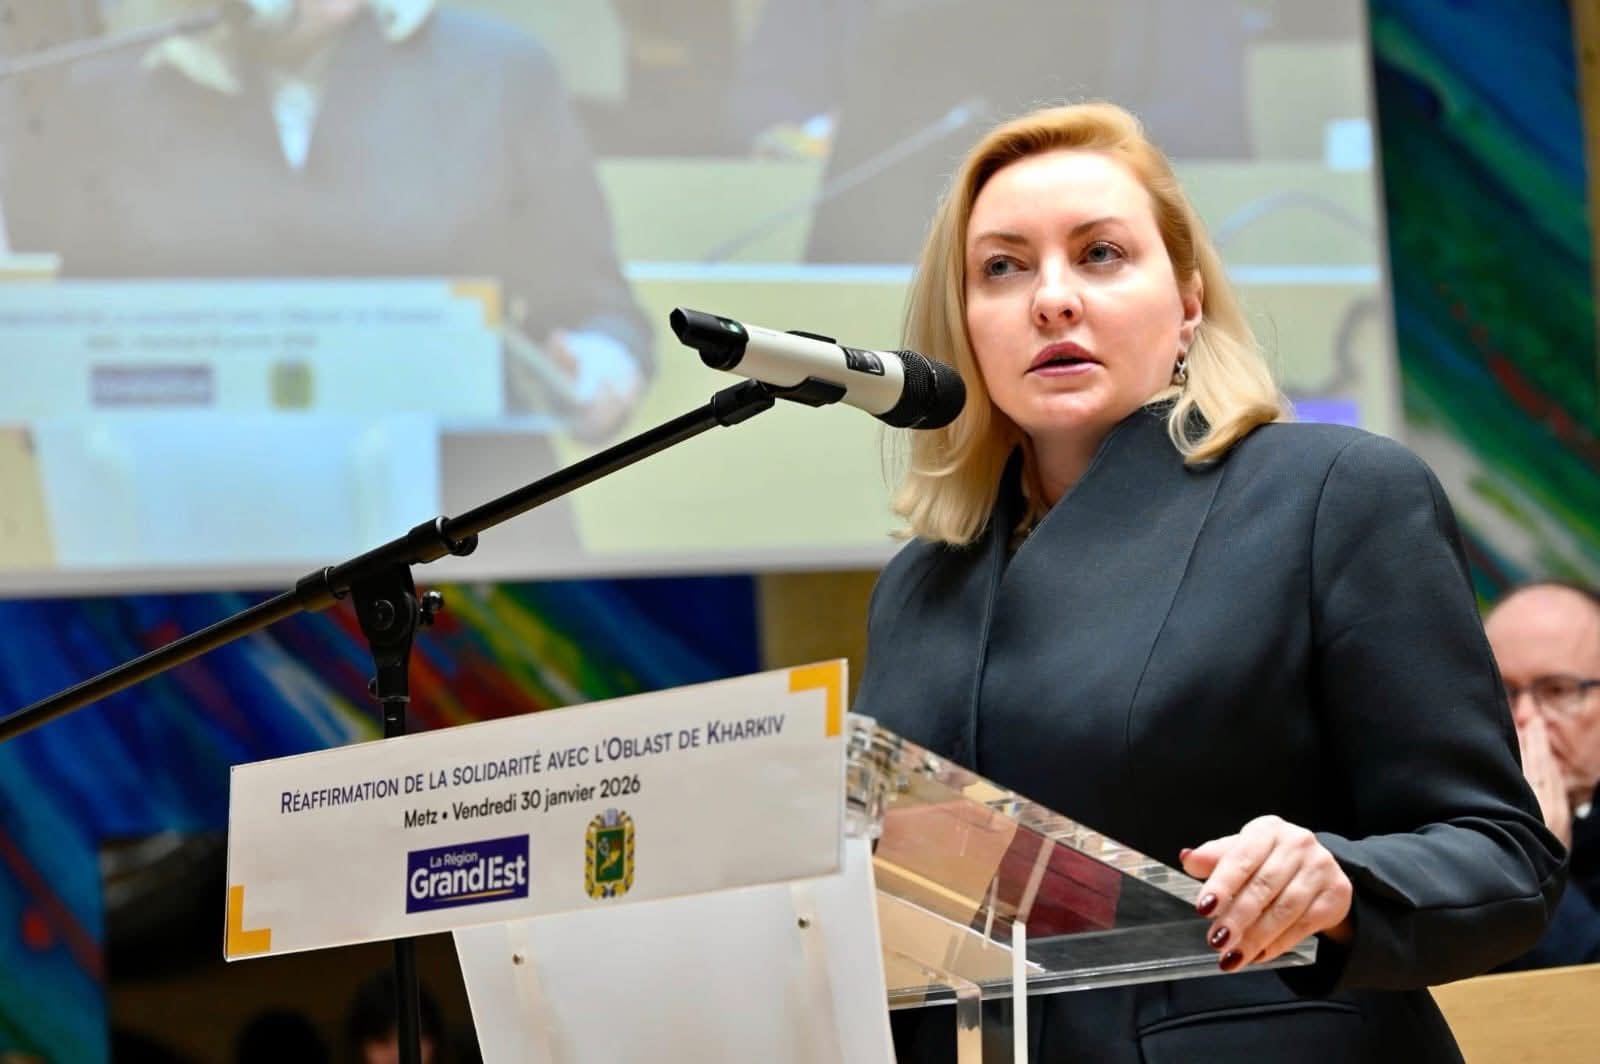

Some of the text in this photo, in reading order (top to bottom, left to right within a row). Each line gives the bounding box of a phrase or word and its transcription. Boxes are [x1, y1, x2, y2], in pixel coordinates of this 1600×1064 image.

[404, 774, 423, 794] DE
[429, 770, 447, 790] LA
[452, 750, 541, 786] SOLIDARITÉ
[547, 746, 589, 771] AVEC
[679, 728, 700, 749] DE
[707, 714, 785, 745] KHARKIV
[404, 809, 438, 829] Metz
[452, 793, 517, 820] Vendredi
[521, 790, 541, 811] 30
[545, 784, 594, 812] janvier
[600, 774, 641, 798] 2026
[430, 851, 478, 867] La Région
